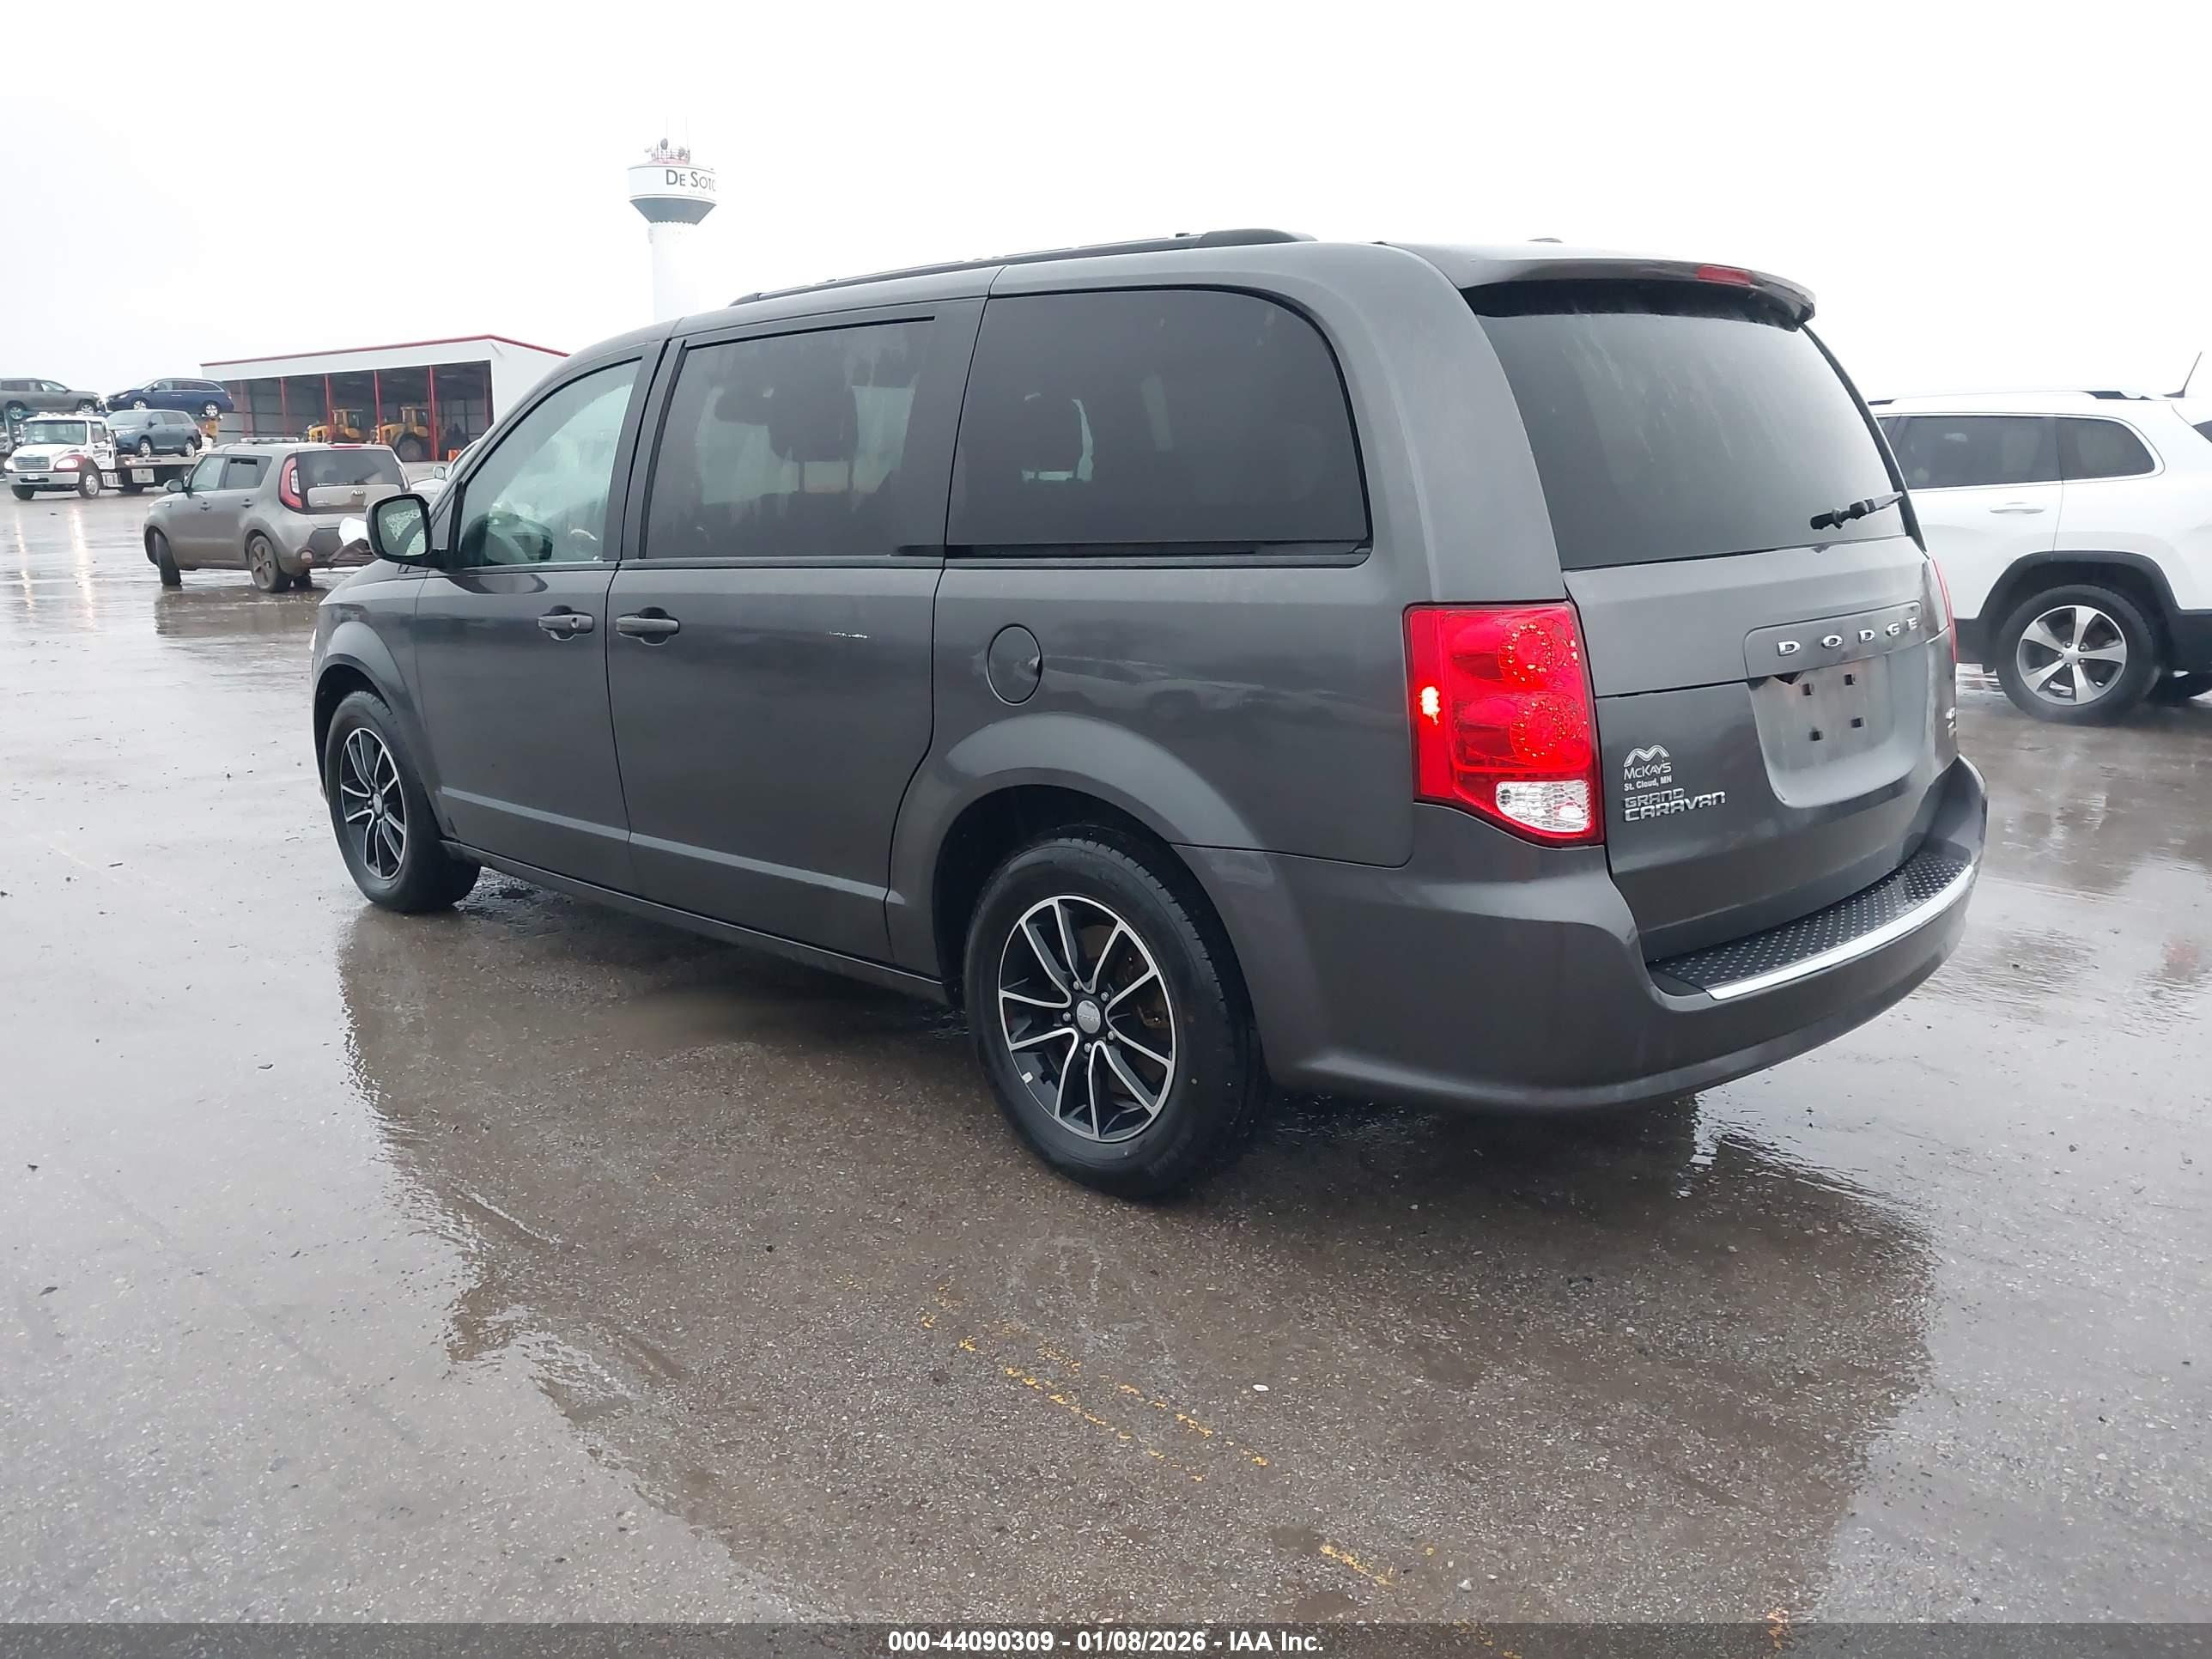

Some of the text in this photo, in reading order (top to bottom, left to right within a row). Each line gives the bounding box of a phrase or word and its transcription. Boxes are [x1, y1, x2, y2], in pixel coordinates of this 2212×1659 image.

[1778, 617, 1918, 656] DODGE
[1624, 775, 1672, 792] St. Cloud, MN
[1625, 787, 1685, 809] GRAND
[1625, 791, 1726, 822] CARAVAN
